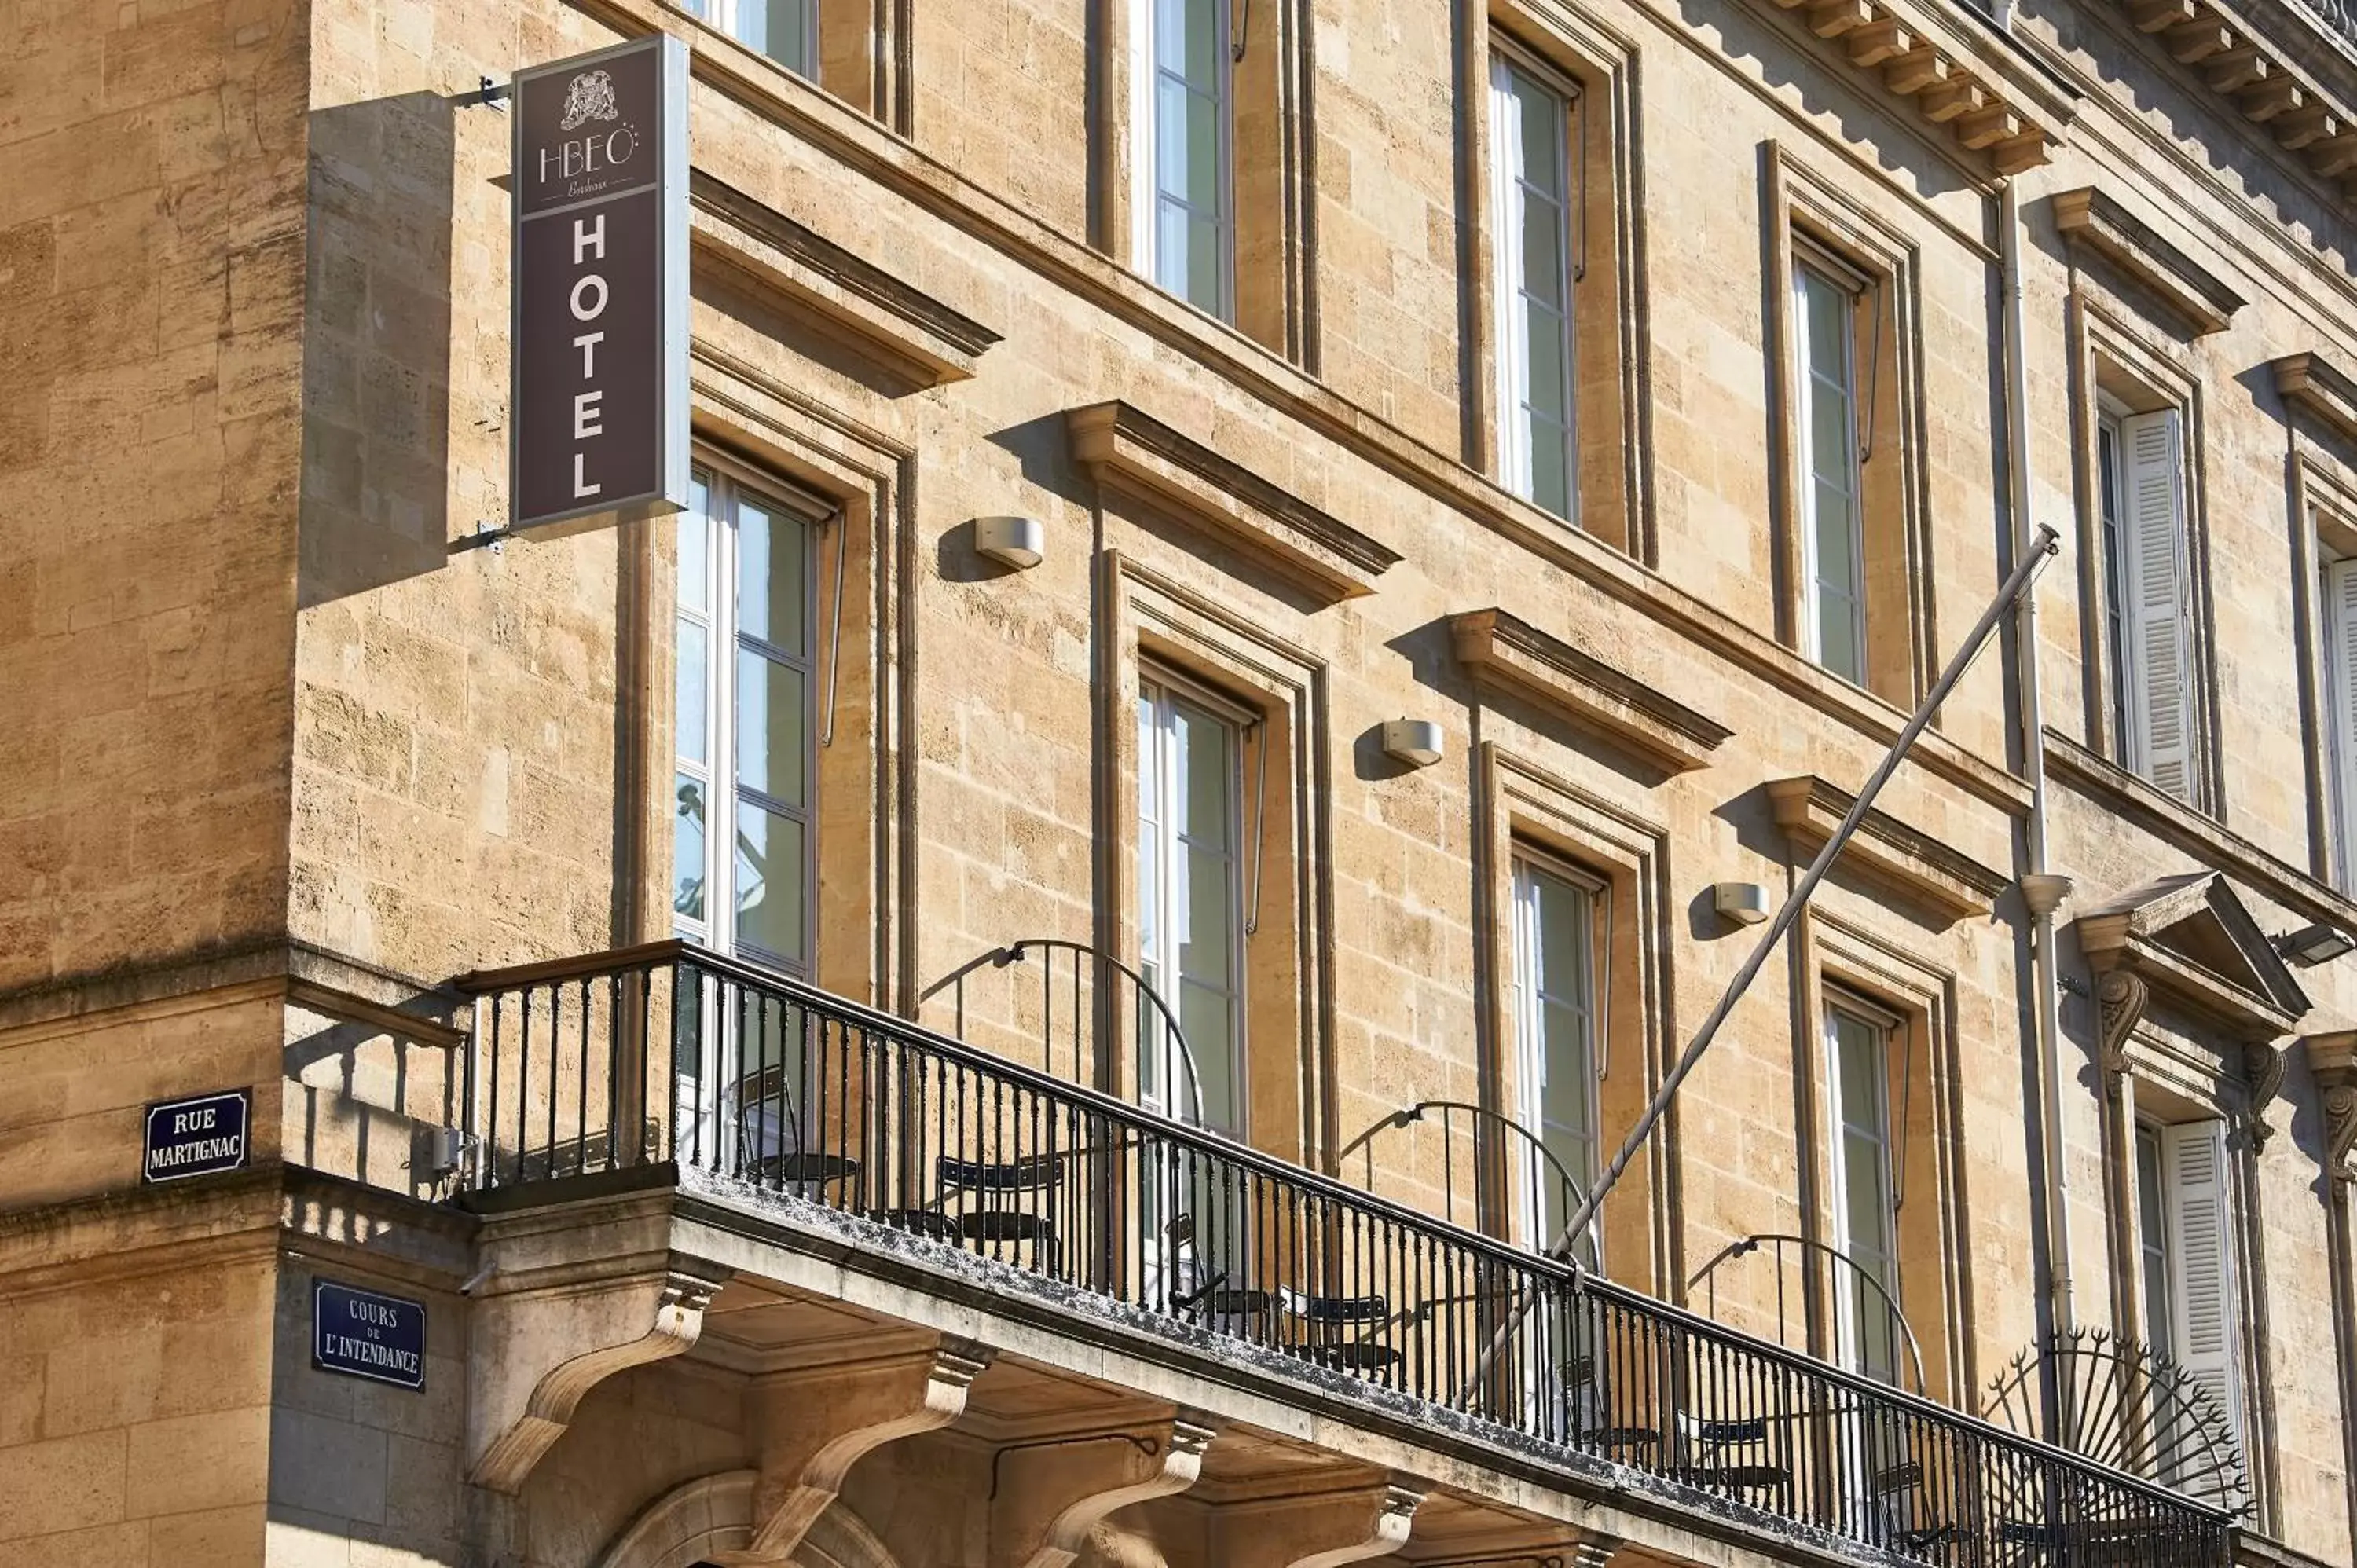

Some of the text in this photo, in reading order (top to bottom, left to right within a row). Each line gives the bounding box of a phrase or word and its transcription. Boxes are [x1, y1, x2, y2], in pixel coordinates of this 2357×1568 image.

[570, 214, 609, 499] HOTEL
[174, 1108, 216, 1134] RUE
[150, 1135, 240, 1170] MARTIGNAC
[350, 1300, 397, 1328] COURS
[367, 1327, 381, 1339] DE
[326, 1333, 419, 1374] L'INTENDANCE
